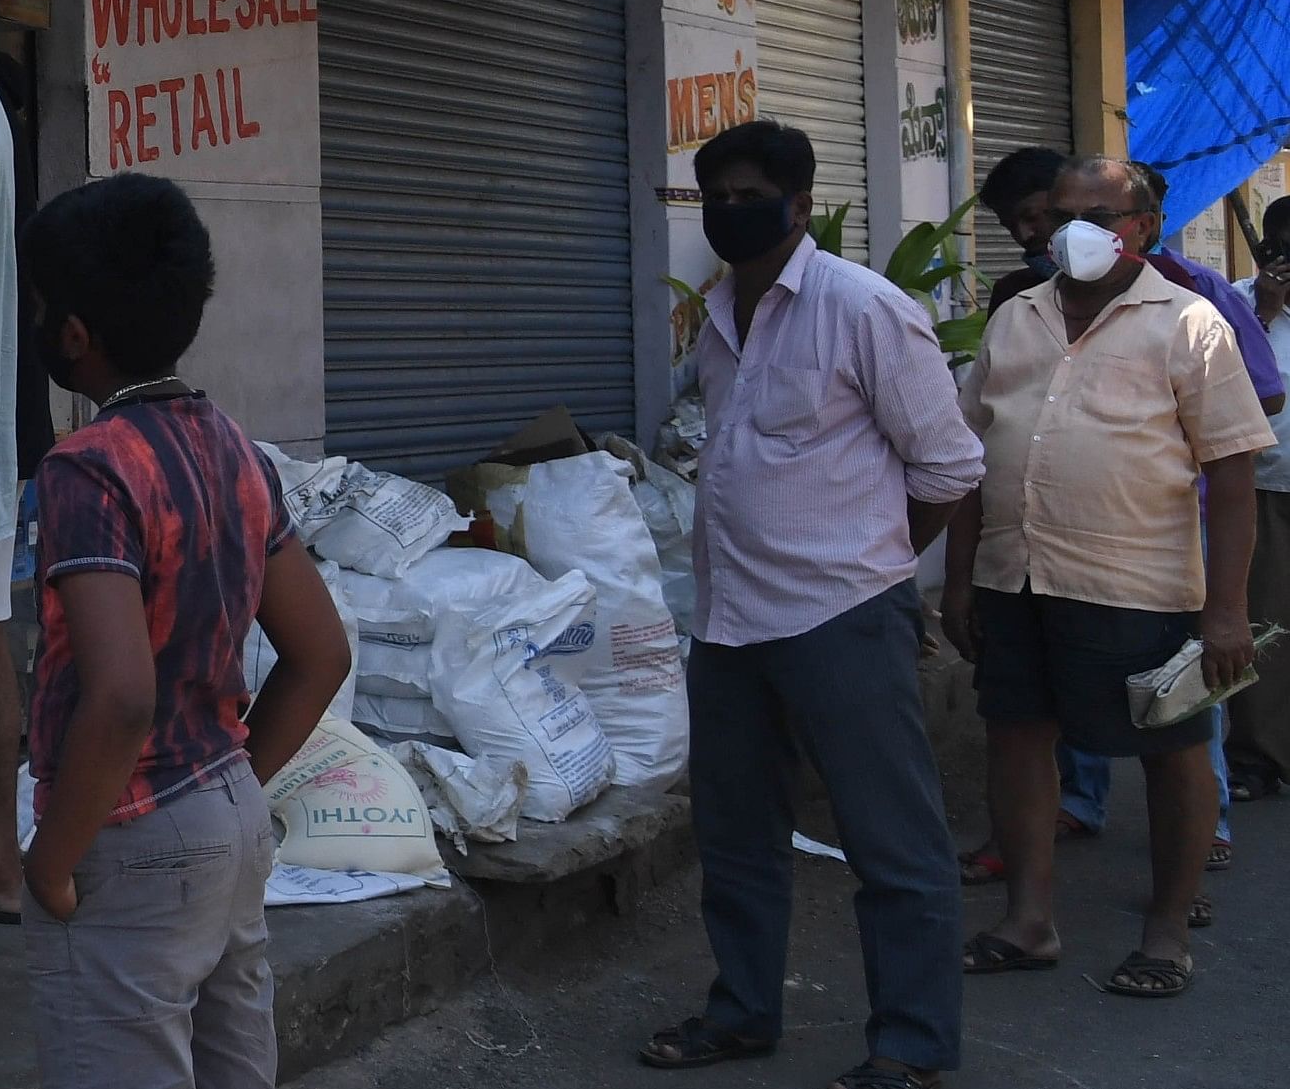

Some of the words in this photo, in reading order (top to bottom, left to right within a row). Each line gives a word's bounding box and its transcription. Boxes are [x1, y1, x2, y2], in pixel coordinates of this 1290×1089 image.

[108, 67, 261, 170] RETAIL
[667, 49, 756, 155] MEN'S
[313, 807, 417, 823] JYOTHI
